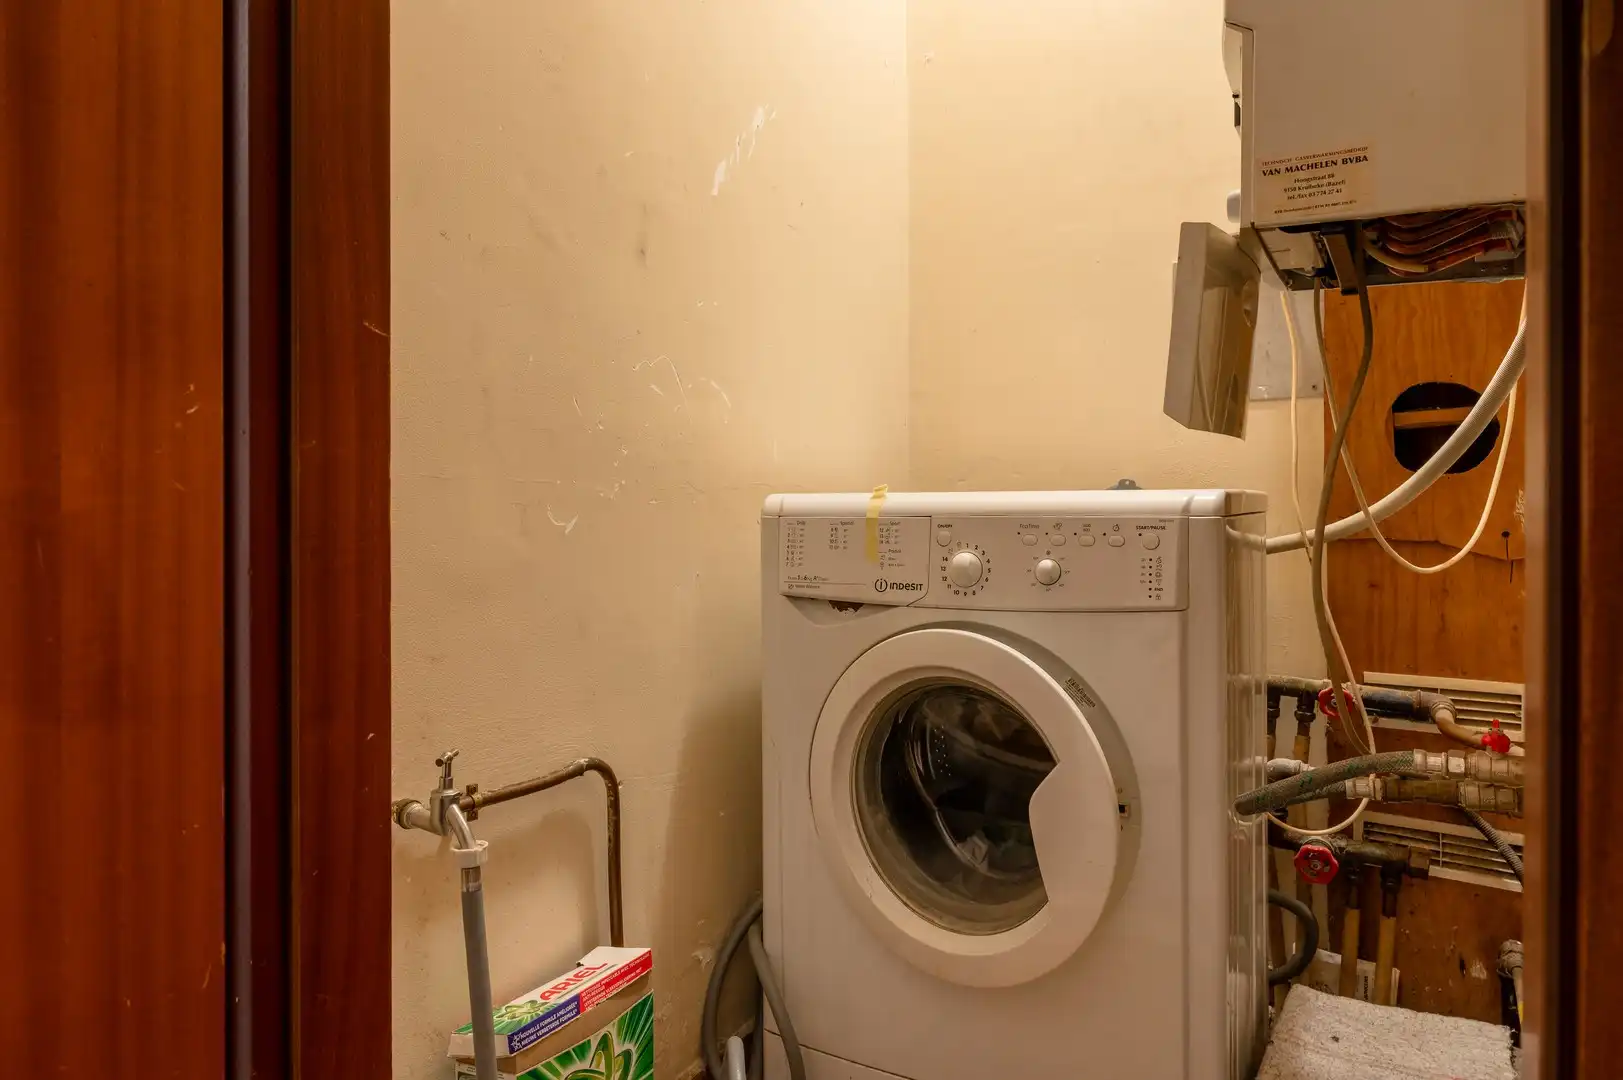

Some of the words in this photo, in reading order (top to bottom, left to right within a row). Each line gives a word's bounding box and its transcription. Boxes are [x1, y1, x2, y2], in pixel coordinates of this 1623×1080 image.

[1262, 167, 1281, 177] VAN
[1284, 159, 1338, 174] MACHELEN
[1341, 154, 1369, 165] BVBA
[1294, 174, 1327, 184] Hoogstraat
[889, 582, 924, 591] INDESIT
[539, 962, 609, 1002] ARIEL
[520, 1023, 540, 1039] NOUVELLE
[540, 1013, 557, 1028] FORMULE
[521, 1034, 537, 1046] NIEUWE
[537, 1019, 560, 1037] VERBETERDE
